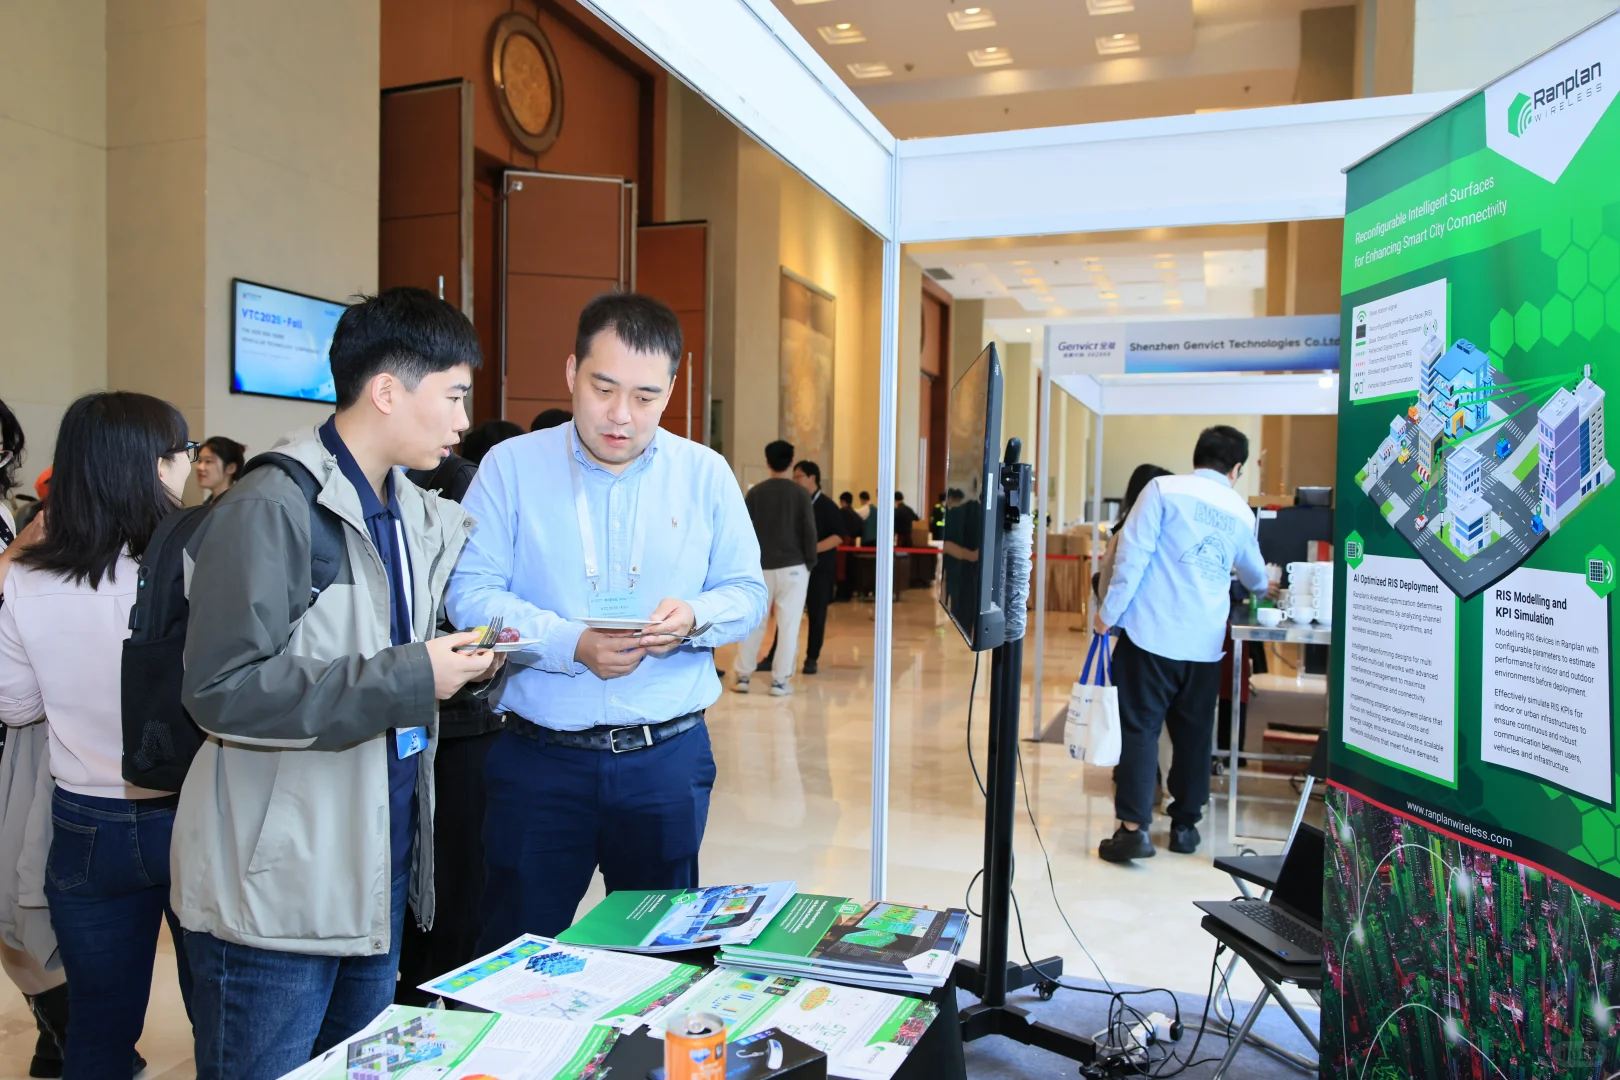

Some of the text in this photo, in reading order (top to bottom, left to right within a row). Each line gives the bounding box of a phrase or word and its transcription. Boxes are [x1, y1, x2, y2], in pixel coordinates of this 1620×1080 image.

[1533, 61, 1602, 110] Ranplan
[1534, 82, 1603, 123] WIRELESS
[1355, 176, 1495, 245] Reconfigurable Intelligent Surfaces
[1354, 198, 1508, 269] for Enhancing Smart City Connectivity
[1058, 341, 1098, 351] Genvict
[1129, 341, 1180, 352] Shenzhen
[1183, 339, 1224, 350] Genvict
[1229, 337, 1301, 350] Technologies
[1353, 573, 1439, 594] AI Optimized RIS Deployment
[1416, 601, 1443, 611] determines
[1496, 589, 1567, 610] RIS Modelling and
[1395, 610, 1400, 618] by
[1401, 612, 1422, 623] analyzing
[1422, 615, 1441, 624] channel
[1496, 606, 1554, 626] KPI Simulation
[1424, 627, 1432, 635] and
[1495, 627, 1599, 655] Modelling RIS devices in Ranplan with
[1395, 652, 1412, 662] designs
[1495, 642, 1595, 669] configurable parameters to estimate
[1405, 666, 1415, 674] with
[1415, 669, 1439, 681] advanced
[1495, 655, 1595, 684] performance for indoor and outdoor
[1389, 687, 1397, 695] and
[1495, 669, 1588, 698] environments before deployment.
[1494, 688, 1583, 718] Effectively simulate RIS KPIs for
[1406, 722, 1419, 732] costs
[1420, 726, 1429, 735] and
[1419, 713, 1432, 723] plans
[1432, 717, 1443, 726] that
[1494, 701, 1587, 735] indoor or urban infrastructures to
[1493, 716, 1577, 747] ensure continuous and robust
[1414, 736, 1423, 745] and
[1423, 740, 1444, 752] scalable
[1493, 730, 1582, 764] communication between users,
[1493, 743, 1520, 756] vehicles
[1521, 751, 1533, 760] and
[1406, 801, 1513, 848] www.ranplanwireless.com
